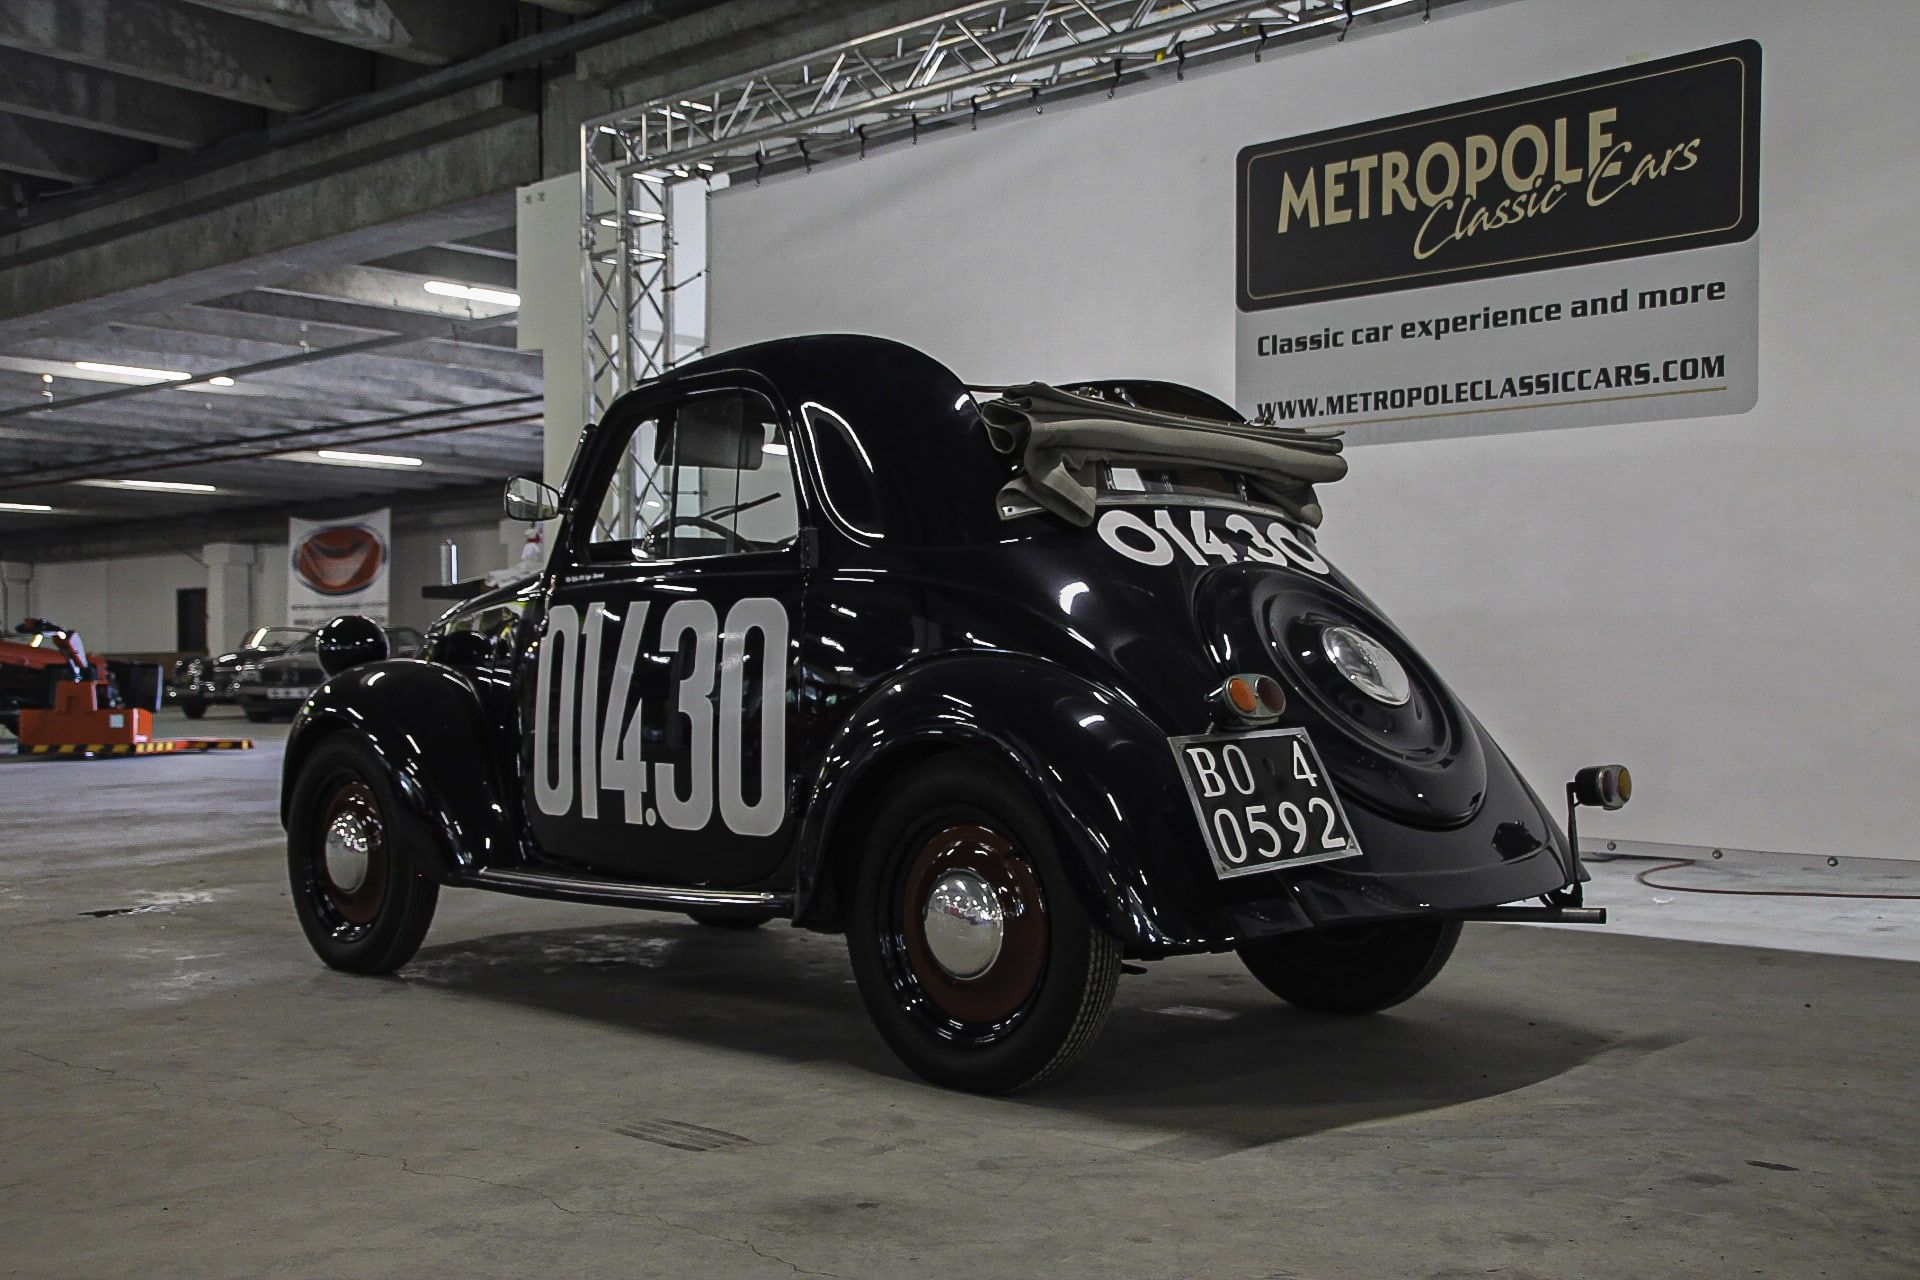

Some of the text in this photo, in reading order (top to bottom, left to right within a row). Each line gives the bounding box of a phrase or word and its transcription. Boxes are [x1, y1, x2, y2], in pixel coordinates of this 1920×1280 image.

[1278, 108, 1621, 233] METROPOLE
[1413, 137, 1700, 260] Classic Cars
[1257, 281, 1726, 357] Classic car experience and more
[1257, 355, 1726, 421] WWW.METROPOLECLASSICCARS.COM
[534, 598, 789, 836] 014.30
[1292, 741, 1317, 787] 4
[1213, 797, 1346, 863] 0592
